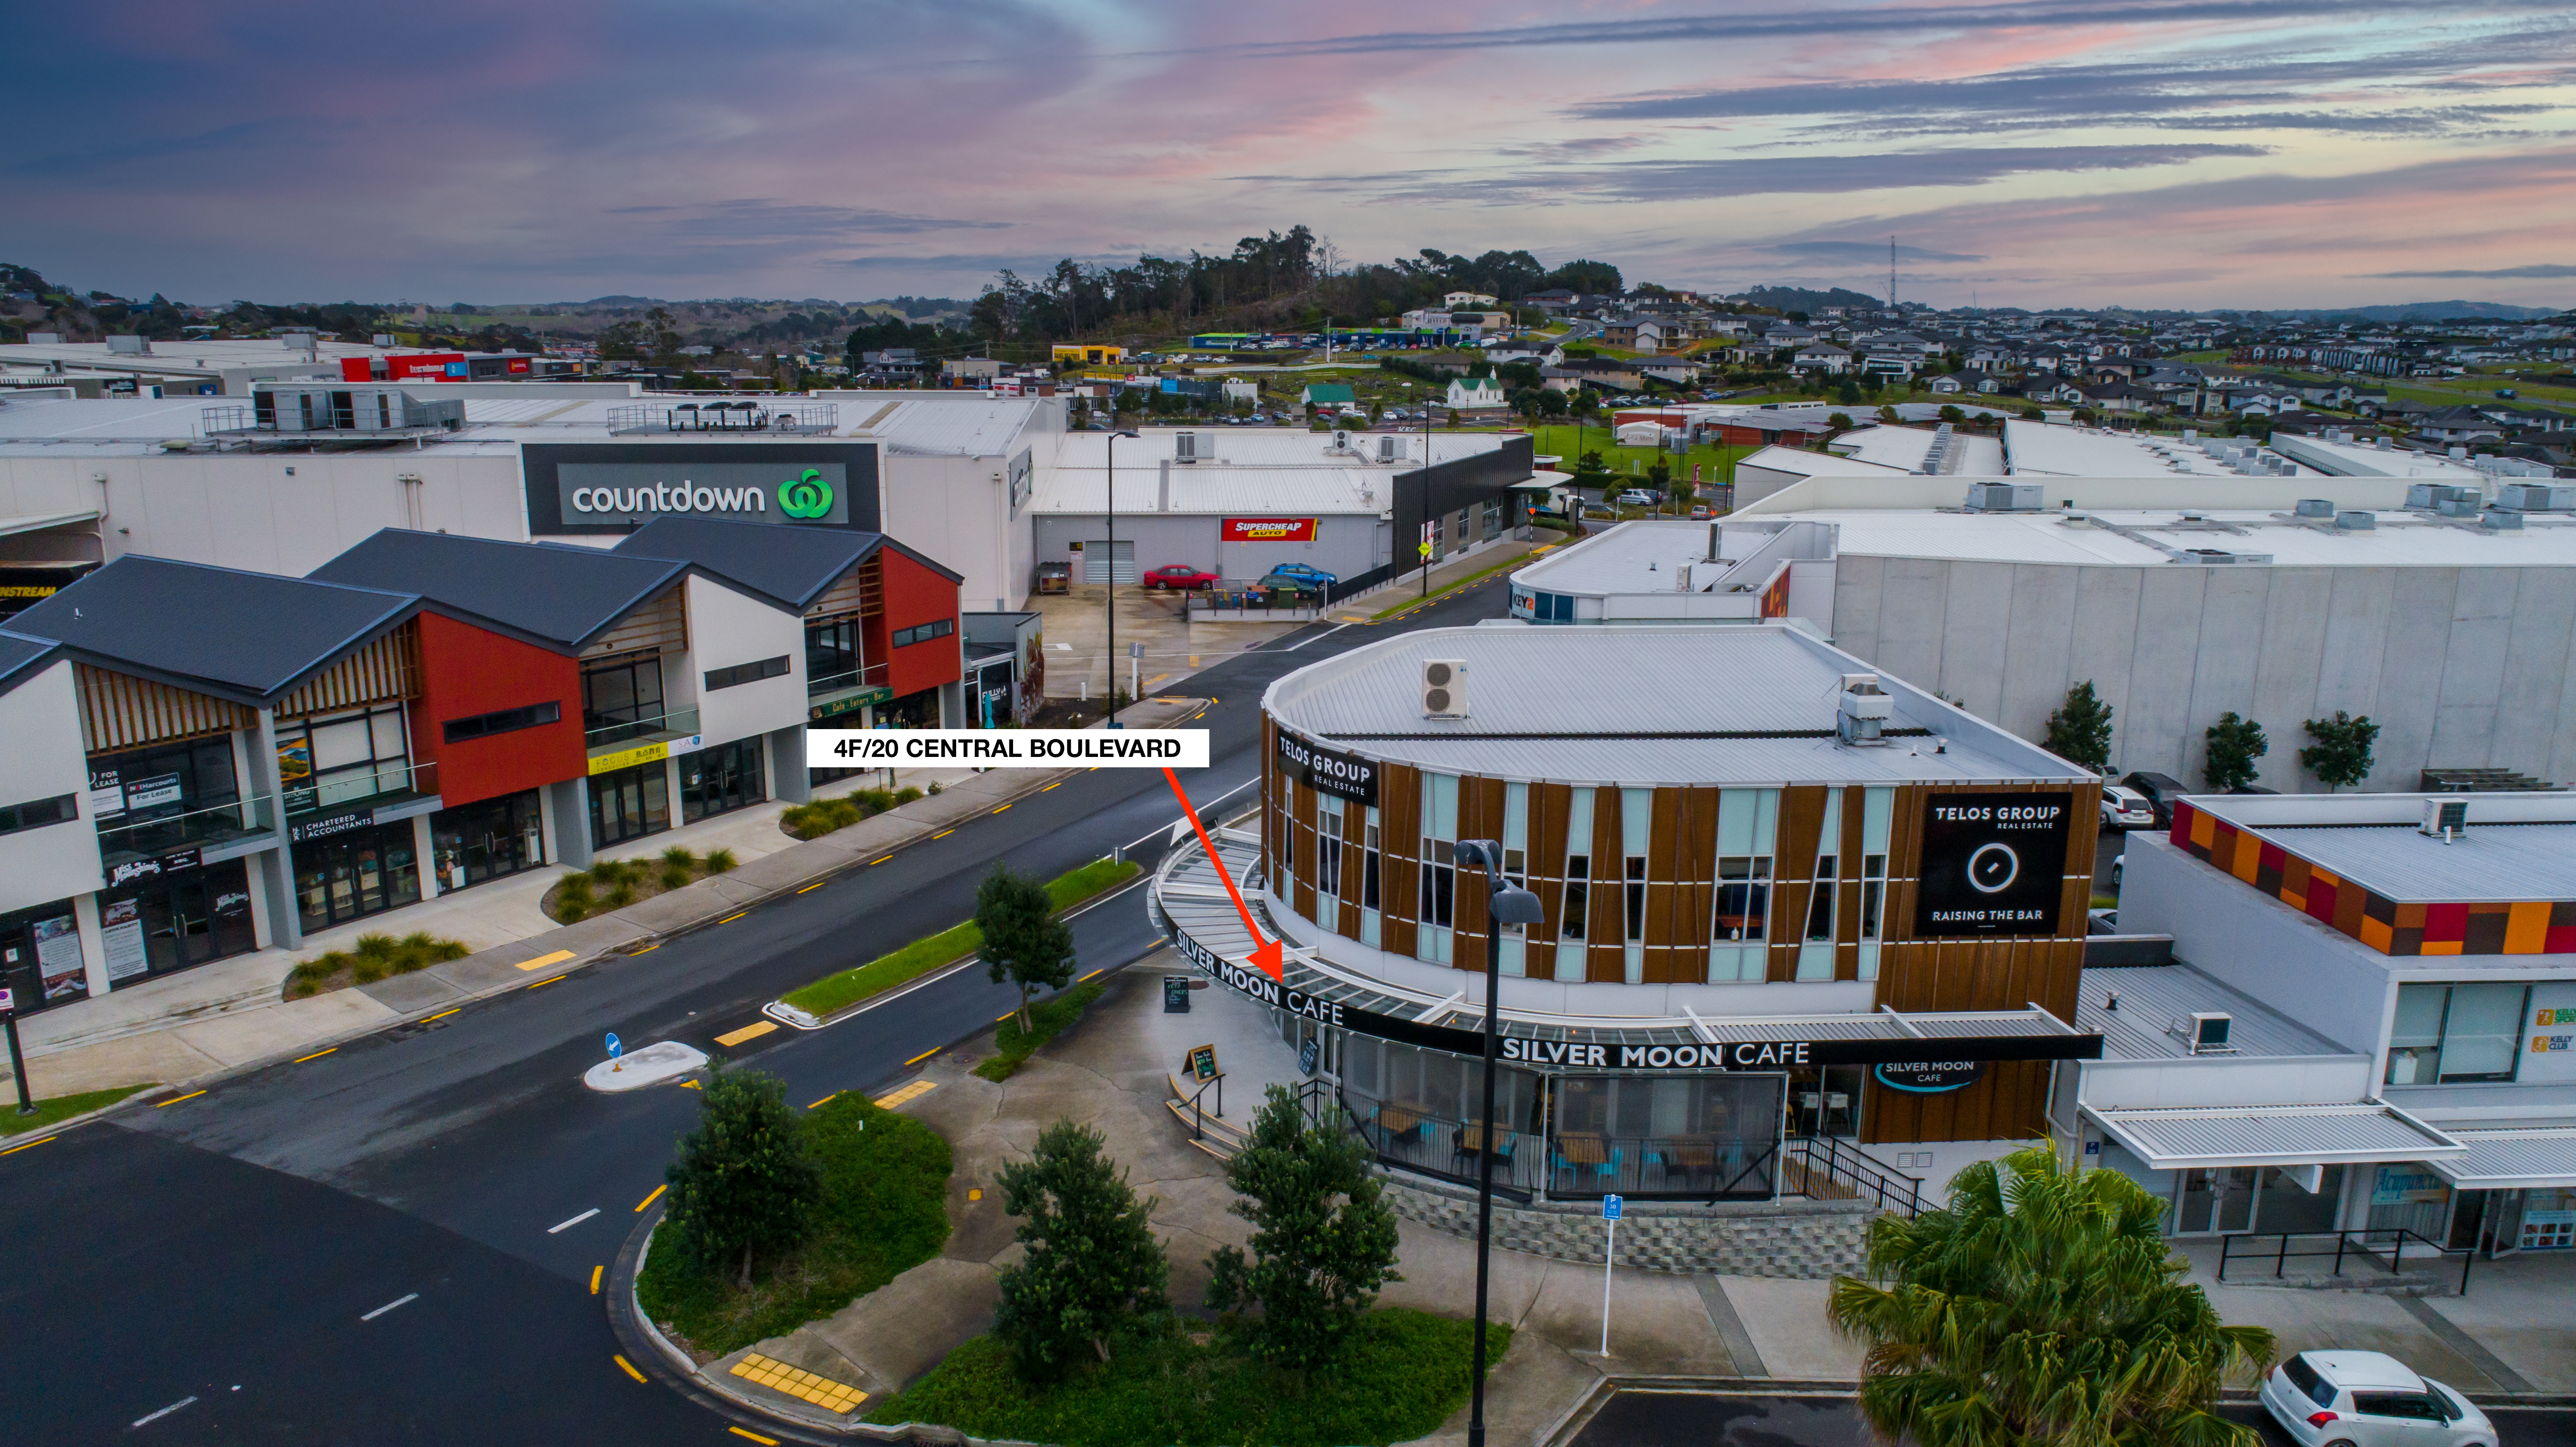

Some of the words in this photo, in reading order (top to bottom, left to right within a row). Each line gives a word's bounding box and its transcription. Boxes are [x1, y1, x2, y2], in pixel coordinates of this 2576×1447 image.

[572, 480, 765, 512] countdown
[1235, 522, 1302, 531] SUPERCHEAP
[1513, 592, 1535, 610] KEY2
[850, 697, 869, 707] Eatery
[874, 692, 884, 700] Bar
[596, 753, 629, 767] FOCUS
[1280, 736, 1309, 765] TELOS
[1313, 755, 1370, 782] GROUP
[101, 771, 118, 779] FOR
[95, 778, 119, 788] LEASE
[1314, 774, 1332, 787] REAL
[1335, 781, 1365, 796] ESTATE
[137, 792, 149, 800] For
[151, 788, 172, 797] Lease
[1936, 807, 1991, 820] TELOS
[1997, 806, 2060, 820] GROUP
[306, 814, 355, 830] CHARTERED
[308, 818, 372, 838] ACCOUNTANTS
[1932, 911, 1985, 921] RAISING
[1989, 910, 2014, 920] THE
[2017, 910, 2042, 920] BAR
[1177, 929, 1215, 974] SILVER
[1221, 961, 1279, 1005] MOON
[1288, 991, 1343, 1026] CAFE
[1503, 1038, 1607, 1066] SILVER
[1621, 1045, 1723, 1067] MOON
[1735, 1042, 1810, 1064] CAFE
[1886, 1062, 1928, 1072] SILVER
[1932, 1061, 1974, 1071] MOON
